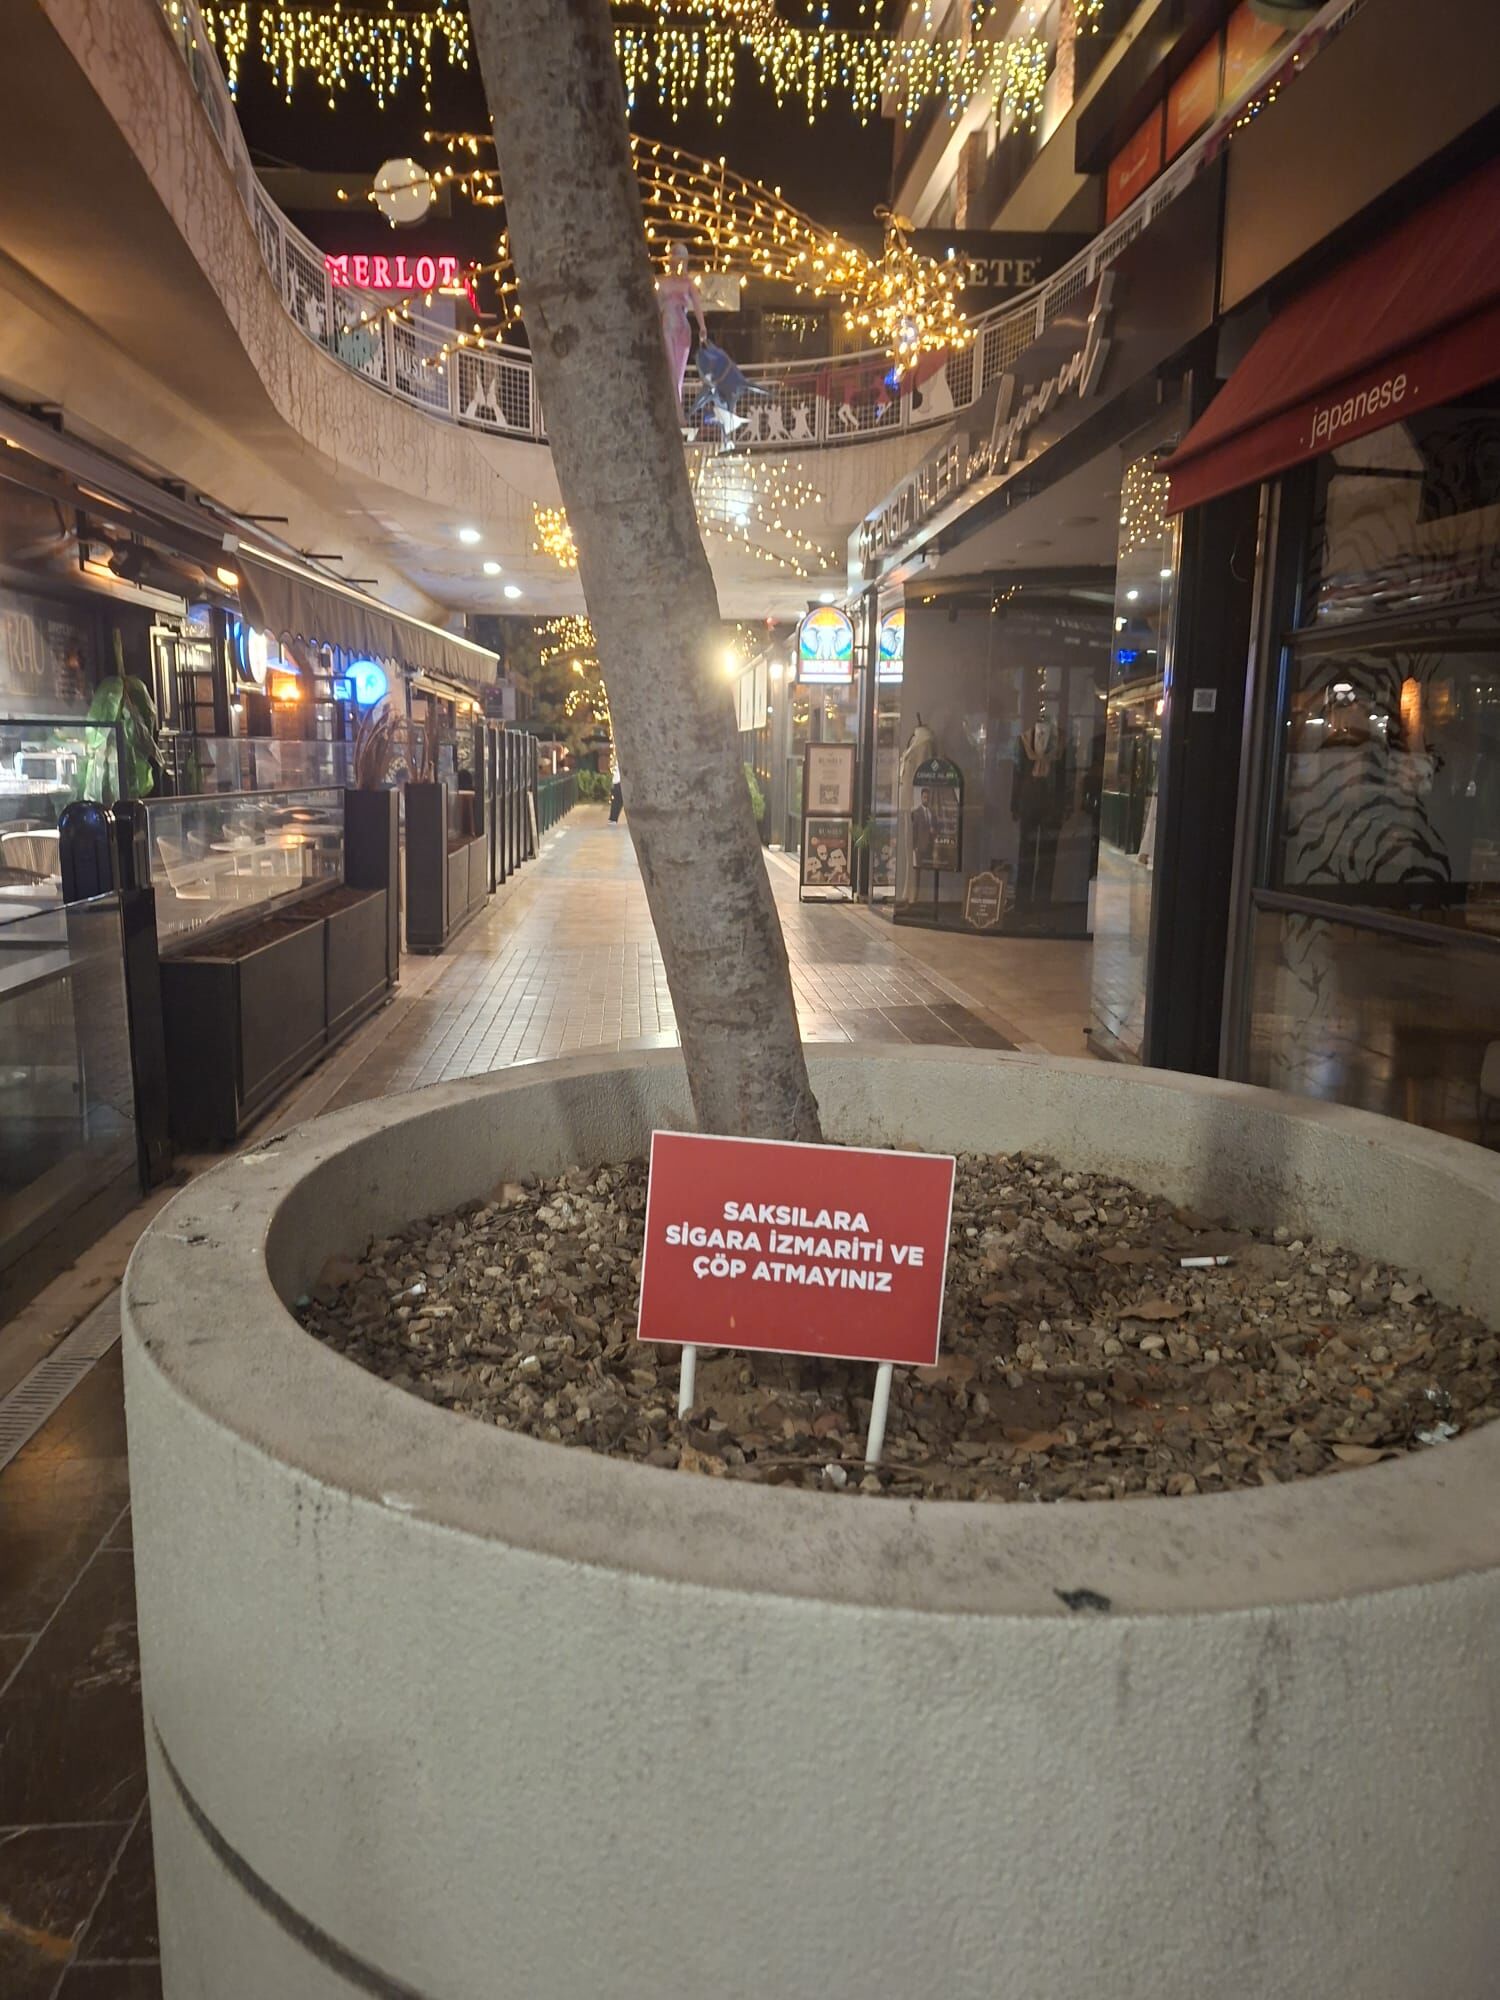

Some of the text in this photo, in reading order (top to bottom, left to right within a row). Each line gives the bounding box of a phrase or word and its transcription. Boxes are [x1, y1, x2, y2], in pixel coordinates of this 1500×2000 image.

[325, 254, 456, 289] MERLOT
[1309, 373, 1407, 449] japanese
[723, 1201, 869, 1232] SAKSILARA
[665, 1222, 924, 1267] SİGARA İZMARİTİ VE
[693, 1253, 893, 1292] ÇÖP ATMAYINIZ
